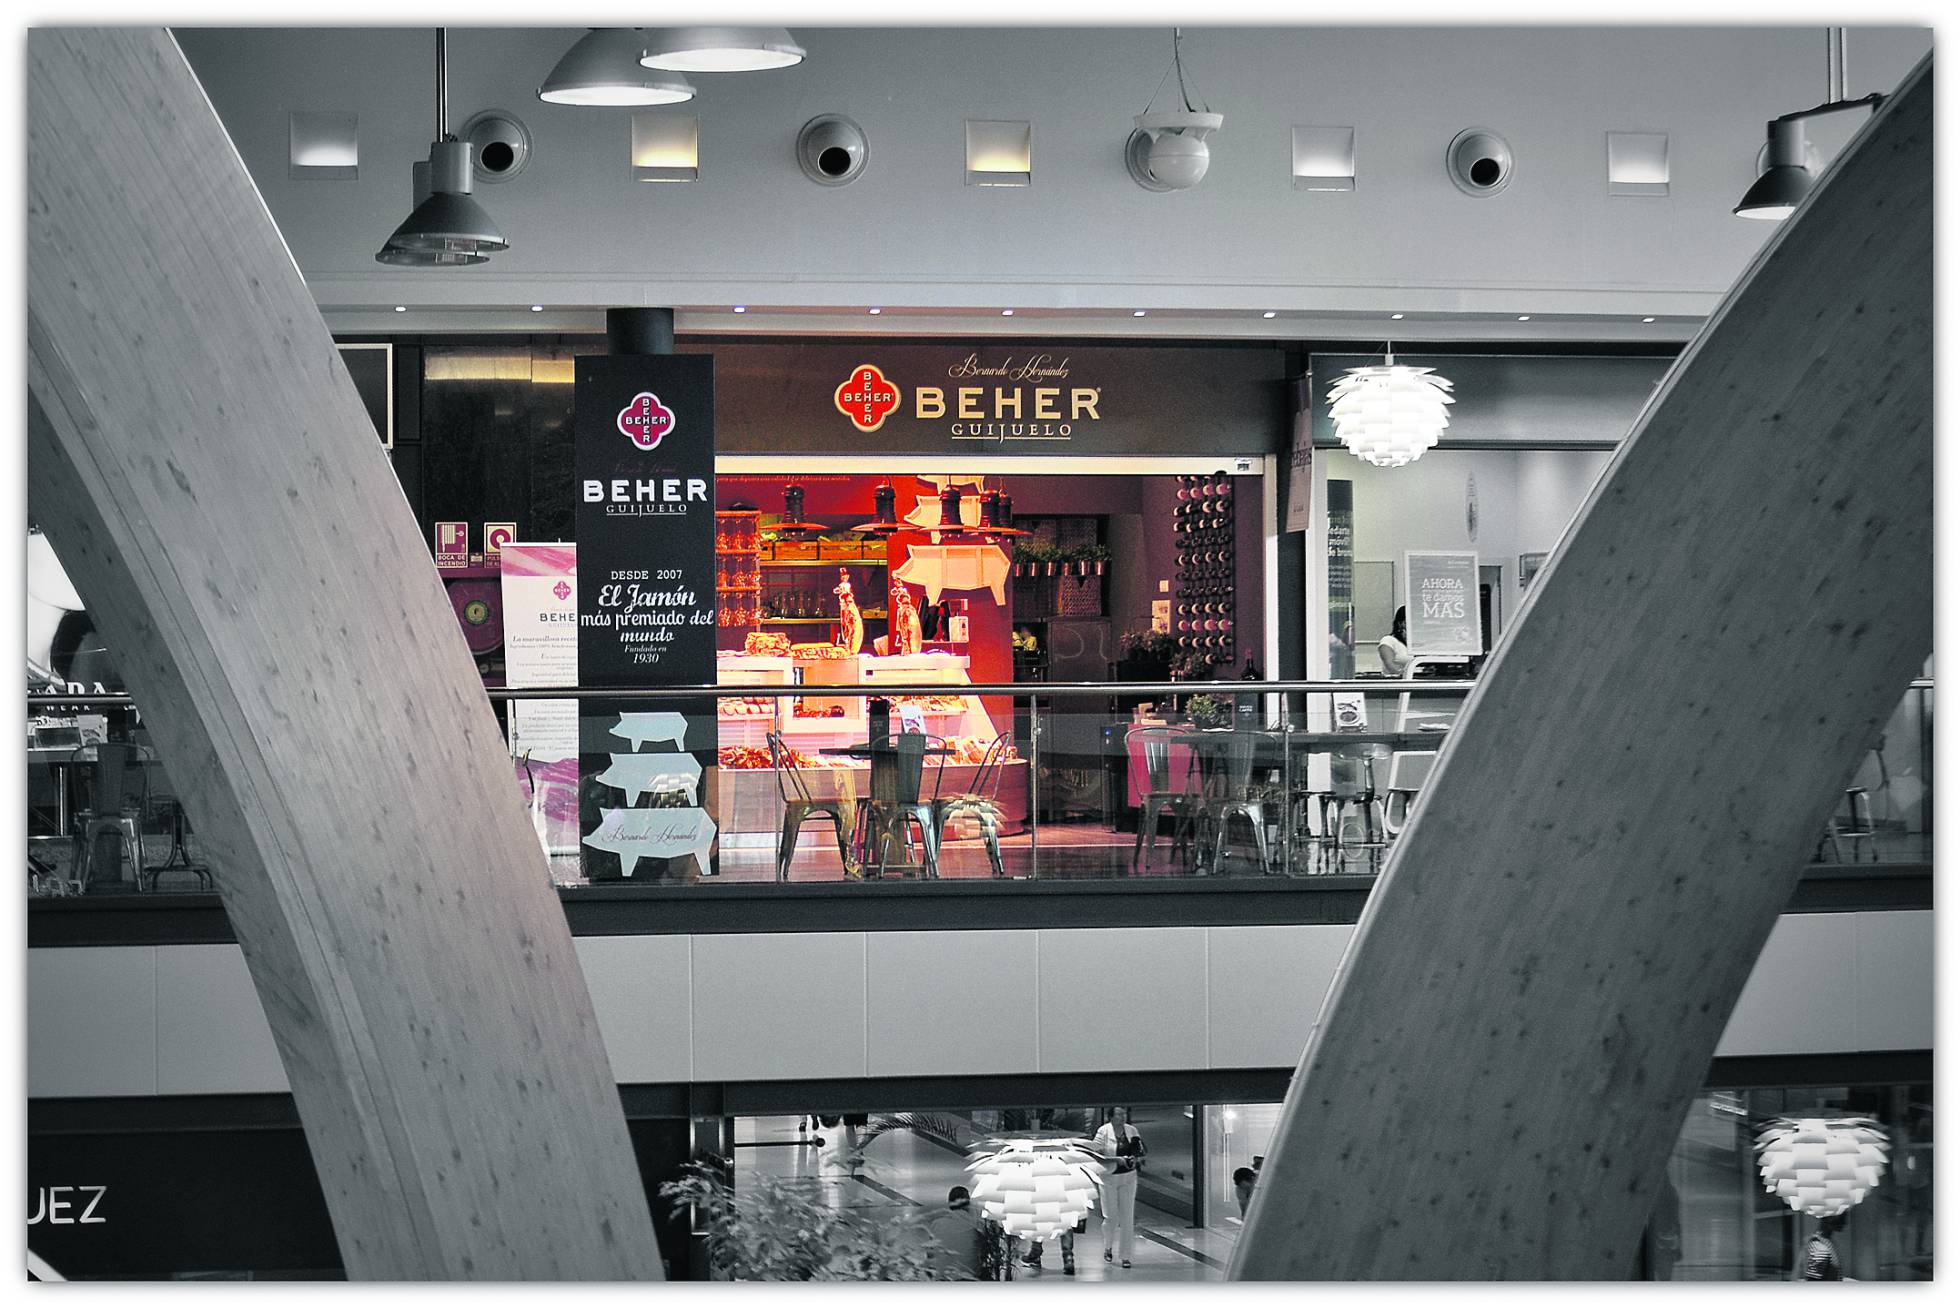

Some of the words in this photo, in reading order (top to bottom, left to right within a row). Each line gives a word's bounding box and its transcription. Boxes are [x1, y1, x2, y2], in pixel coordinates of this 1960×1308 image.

[844, 392, 893, 402] BEHER
[863, 371, 872, 424] BEHER
[916, 387, 1100, 420] BEHER
[625, 416, 668, 425] BEHER
[642, 398, 650, 443] BEHER
[951, 424, 1072, 443] GUIJUELO
[583, 479, 707, 502] BEHER
[605, 504, 687, 517] GUIJUELO
[611, 570, 649, 580] DESDE
[657, 569, 683, 580] 2007
[1422, 577, 1464, 589] AHORA
[598, 584, 622, 607] El
[624, 584, 697, 614] Jamón
[539, 612, 576, 622] BEHE
[580, 610, 612, 626] más
[615, 610, 686, 631] premiado
[688, 610, 714, 626] del
[619, 626, 675, 642] mundo
[624, 644, 657, 653] Fundado
[633, 653, 660, 664] 1930
[28, 682, 106, 695] ADA
